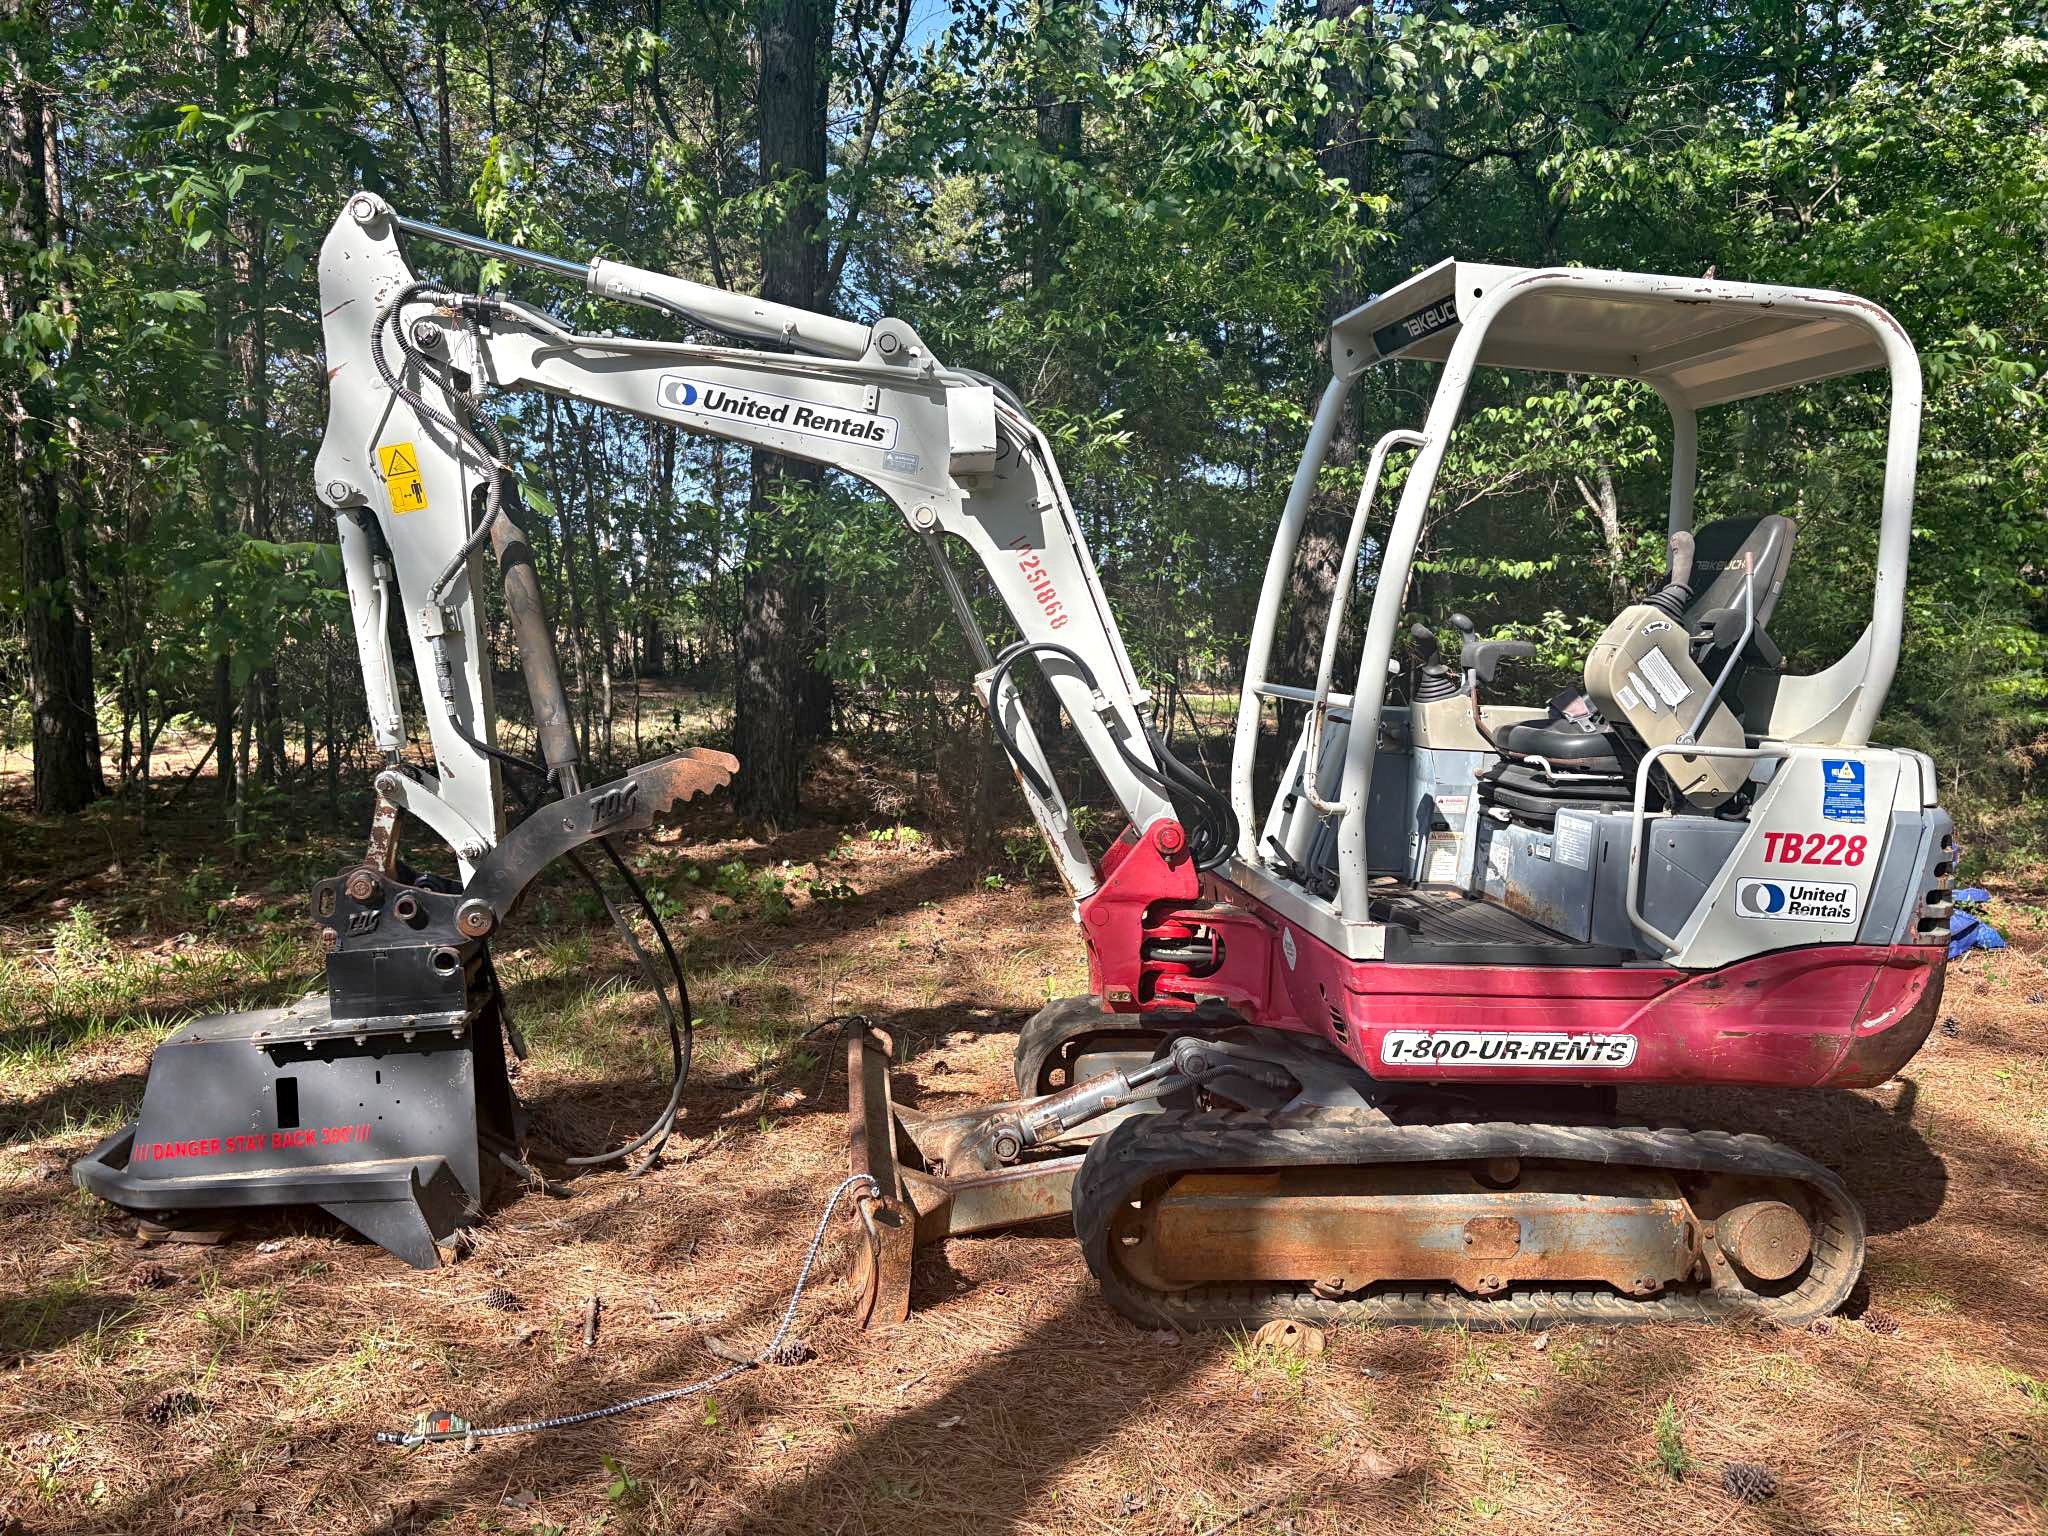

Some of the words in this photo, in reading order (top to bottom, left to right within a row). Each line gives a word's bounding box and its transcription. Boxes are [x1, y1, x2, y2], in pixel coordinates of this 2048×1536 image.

[703, 389, 788, 423] United
[792, 406, 885, 442] Rentals
[1763, 832, 1867, 867] TB228
[1789, 886, 1847, 903] United
[1788, 902, 1851, 918] Rentals
[1391, 1039, 1628, 1061] 1-800-UR-RENTS
[153, 1139, 219, 1161] DANGER
[225, 1135, 266, 1154] STAY
[272, 1128, 317, 1149] BACK
